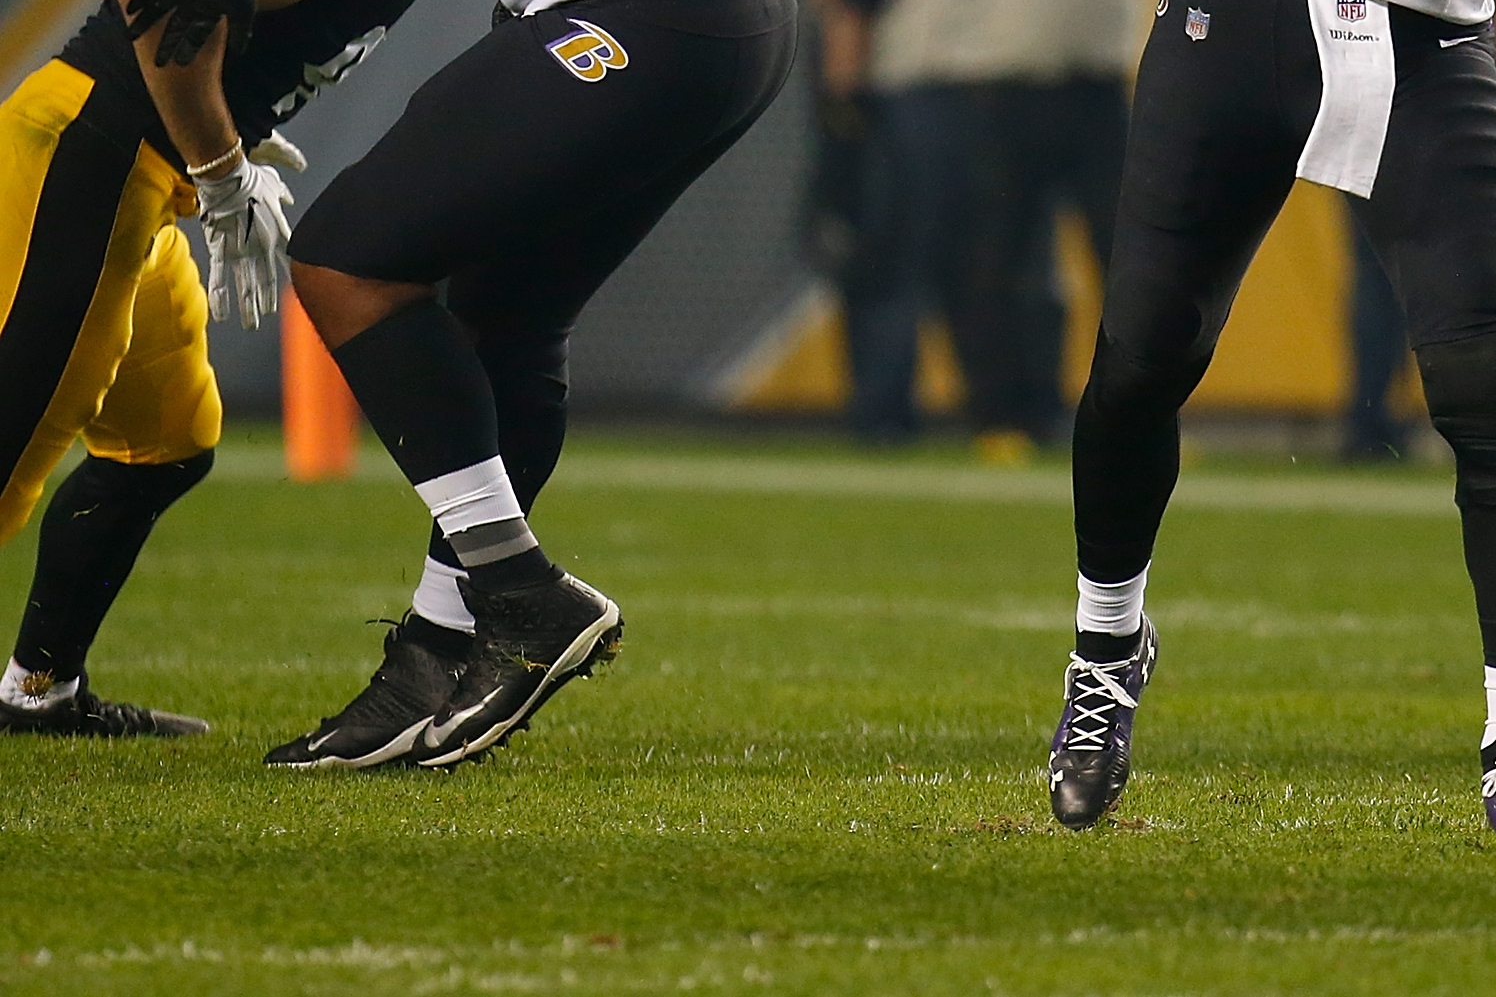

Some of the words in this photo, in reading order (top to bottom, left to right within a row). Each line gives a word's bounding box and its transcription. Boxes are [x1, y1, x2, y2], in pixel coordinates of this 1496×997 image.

[1340, 3, 1365, 20] NFL
[1328, 28, 1376, 43] Wilson
[546, 16, 630, 83] B
